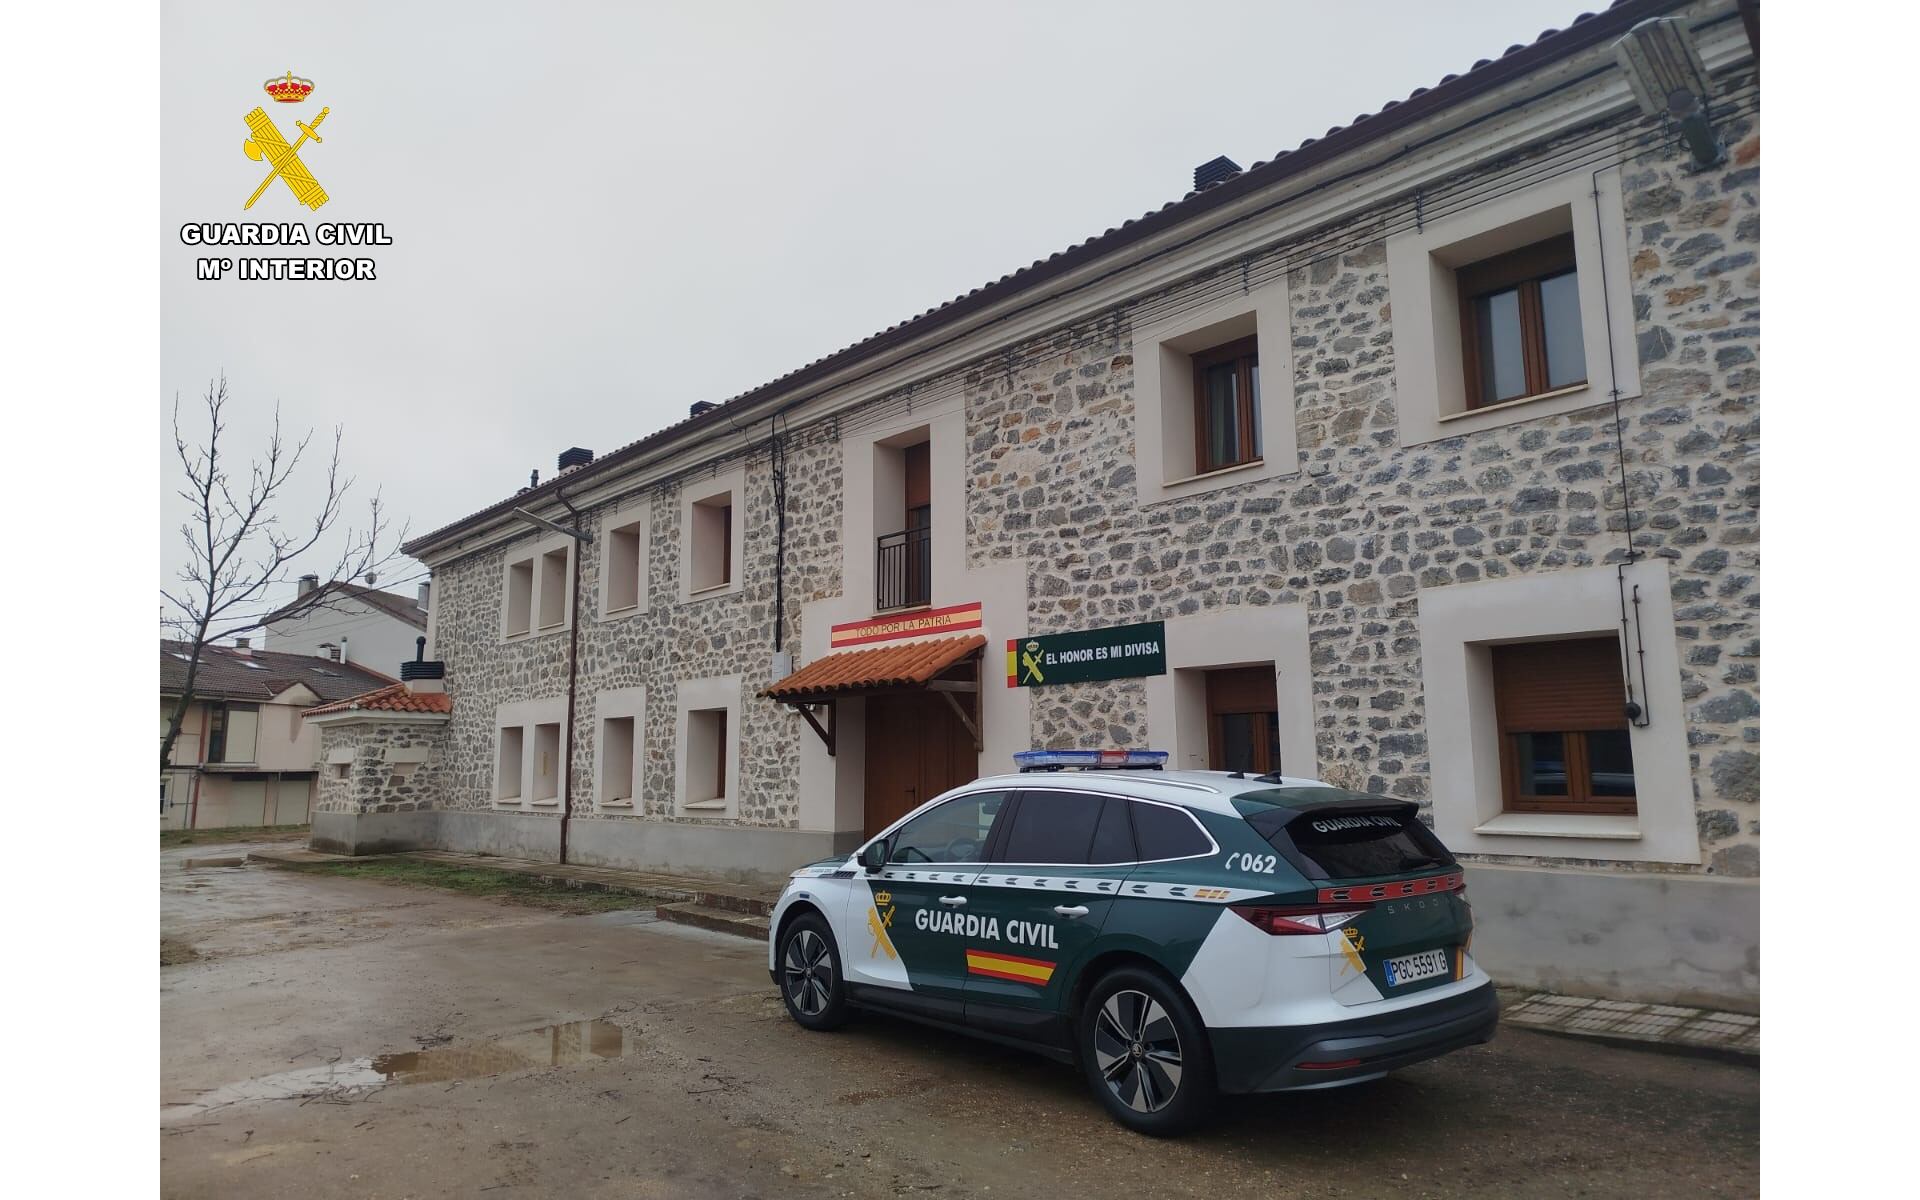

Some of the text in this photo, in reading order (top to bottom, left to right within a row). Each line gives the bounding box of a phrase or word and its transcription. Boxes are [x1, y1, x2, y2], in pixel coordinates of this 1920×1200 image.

[856, 615, 951, 637] TODO POR LA PATRIA
[1046, 641, 1160, 665] EL HONOR ES MI DIVISA
[1312, 815, 1402, 833] GUARDIA CIVIL
[1240, 853, 1277, 874] 062
[915, 908, 1059, 949] GUARDIA CIVIL
[1391, 951, 1447, 981] PGC 5591 G
